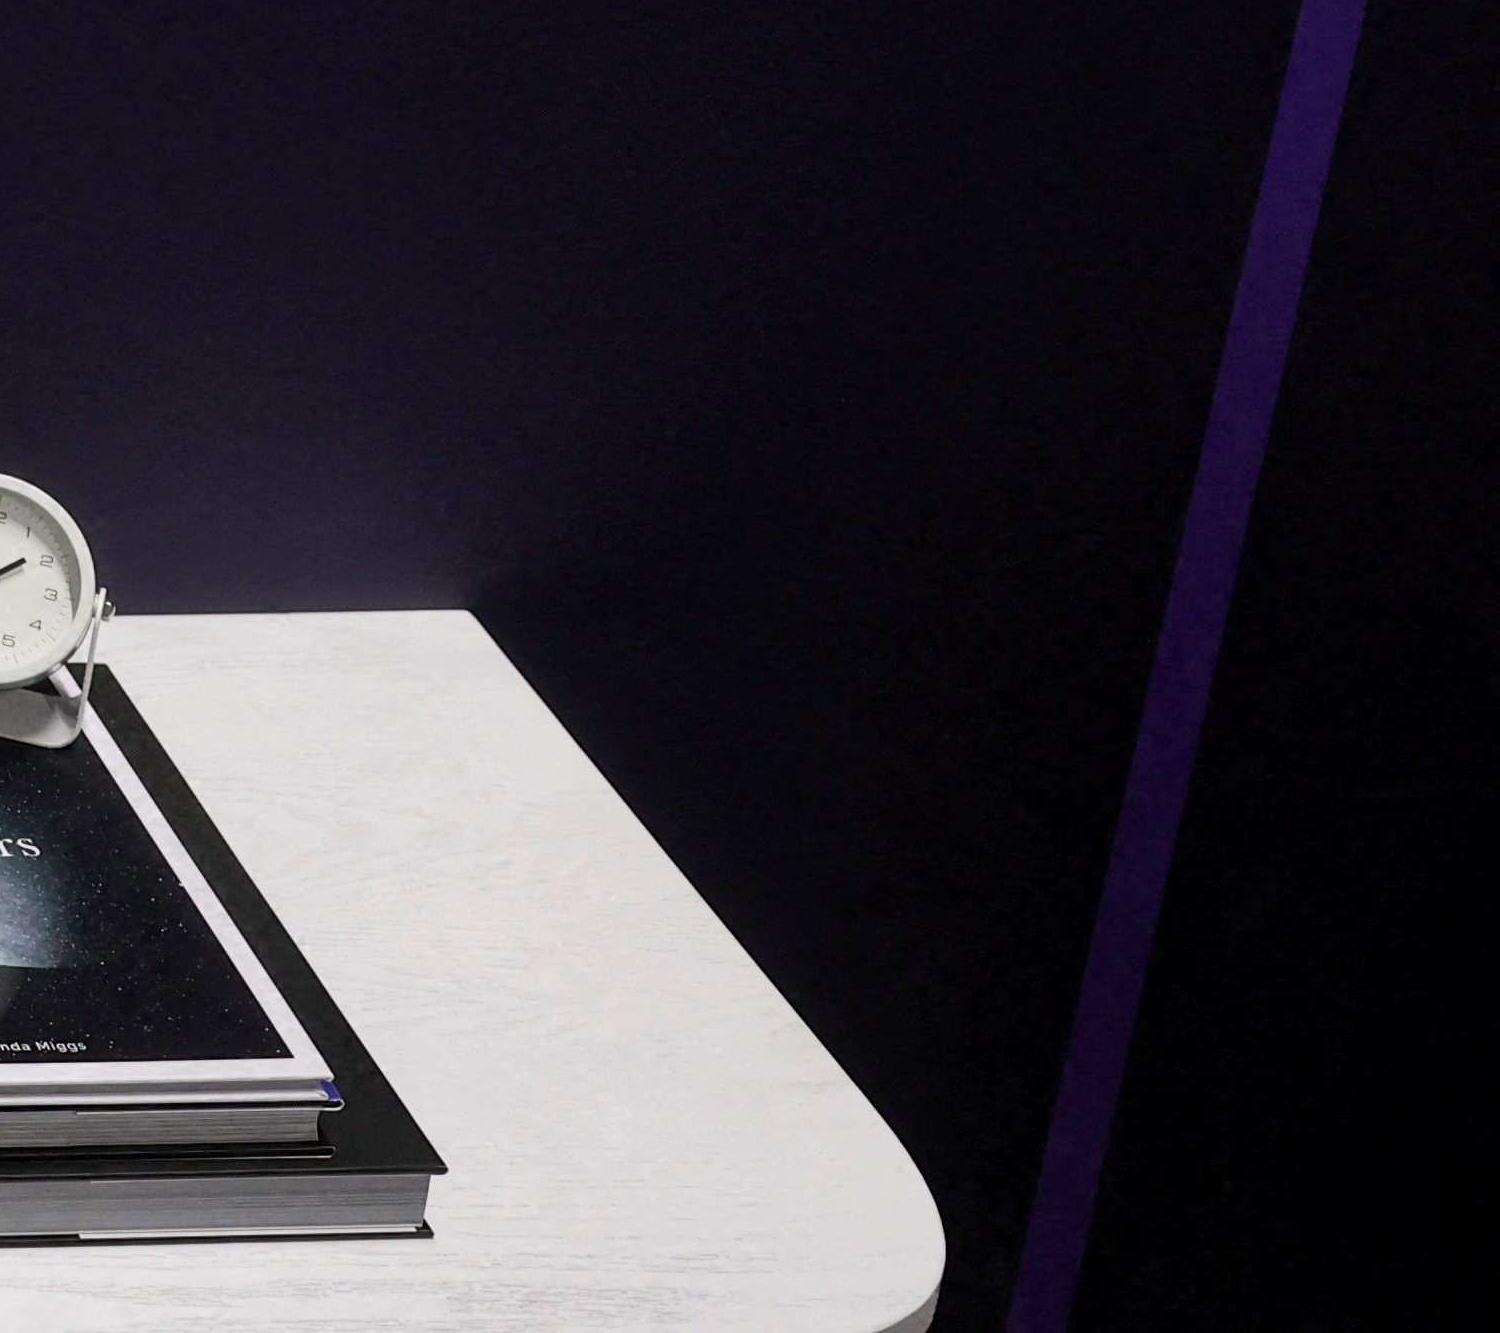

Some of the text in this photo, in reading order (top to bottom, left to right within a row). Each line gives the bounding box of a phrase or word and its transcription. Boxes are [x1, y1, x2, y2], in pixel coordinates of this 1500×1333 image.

[26, 527, 31, 538] 1
[40, 555, 54, 568] 2
[43, 589, 58, 601] 3
[29, 619, 42, 631] 4
[2, 634, 16, 648] 5
[35, 1039, 87, 1053] Miggs
